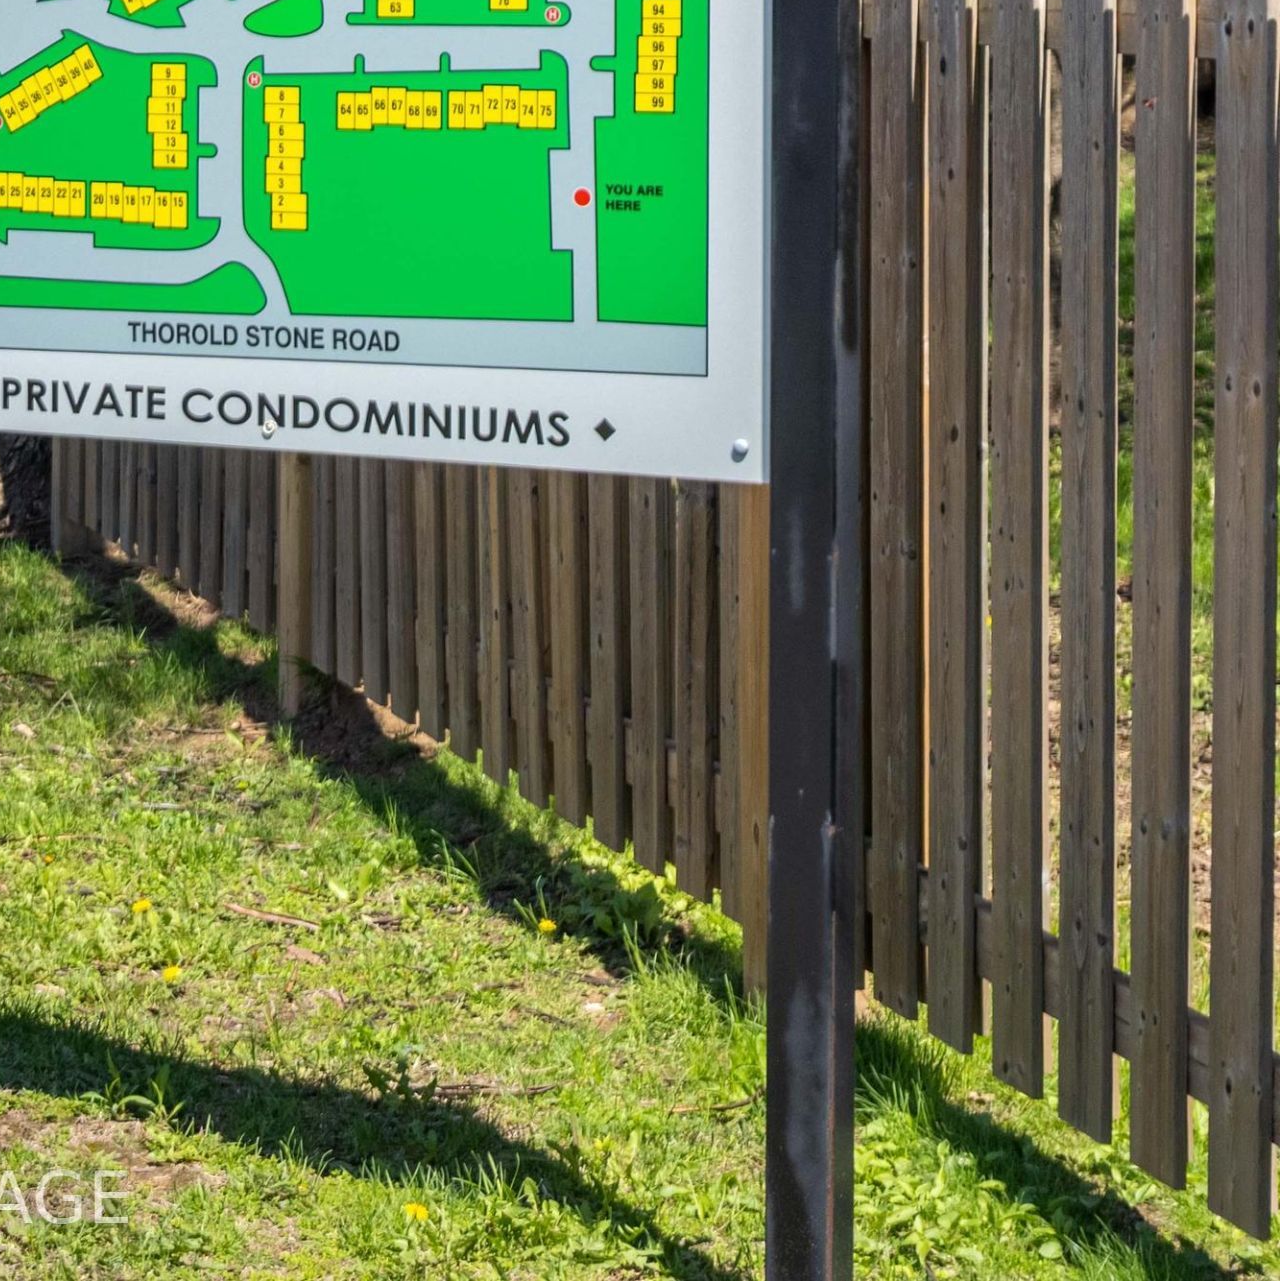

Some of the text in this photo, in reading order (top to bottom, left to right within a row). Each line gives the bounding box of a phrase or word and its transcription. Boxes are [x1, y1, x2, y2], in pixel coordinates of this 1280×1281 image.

[390, 1, 402, 13] 63
[652, 4, 665, 16] 94
[652, 22, 665, 34] 95
[652, 41, 665, 53] 96
[652, 59, 664, 71] 97
[165, 68, 171, 78] 9
[652, 77, 664, 90] 98
[165, 102, 176, 113] 11
[340, 99, 437, 117] 64 65 67 68 69
[452, 98, 552, 116] 70 71 72 73 74 75
[652, 96, 664, 108] 99
[278, 107, 285, 119] 7
[166, 119, 176, 130] 12
[166, 137, 176, 147] 13
[278, 142, 284, 154] 5
[165, 154, 176, 165] 14
[278, 160, 284, 172] 4
[278, 177, 284, 189] 3
[10, 186, 21, 197] 25
[25, 186, 36, 198] 24
[41, 186, 51, 198] 23
[56, 187, 67, 199] 22
[71, 187, 82, 199] 21
[605, 184, 664, 197] YOU ARE
[93, 193, 184, 208] 20 19 17 15
[278, 195, 284, 207] 2
[605, 200, 641, 211] HERE
[278, 212, 284, 224] 1
[127, 321, 402, 354] THOROLD STONE ROAD
[0, 377, 571, 449] PRIVATE CONDOMINIUMS
